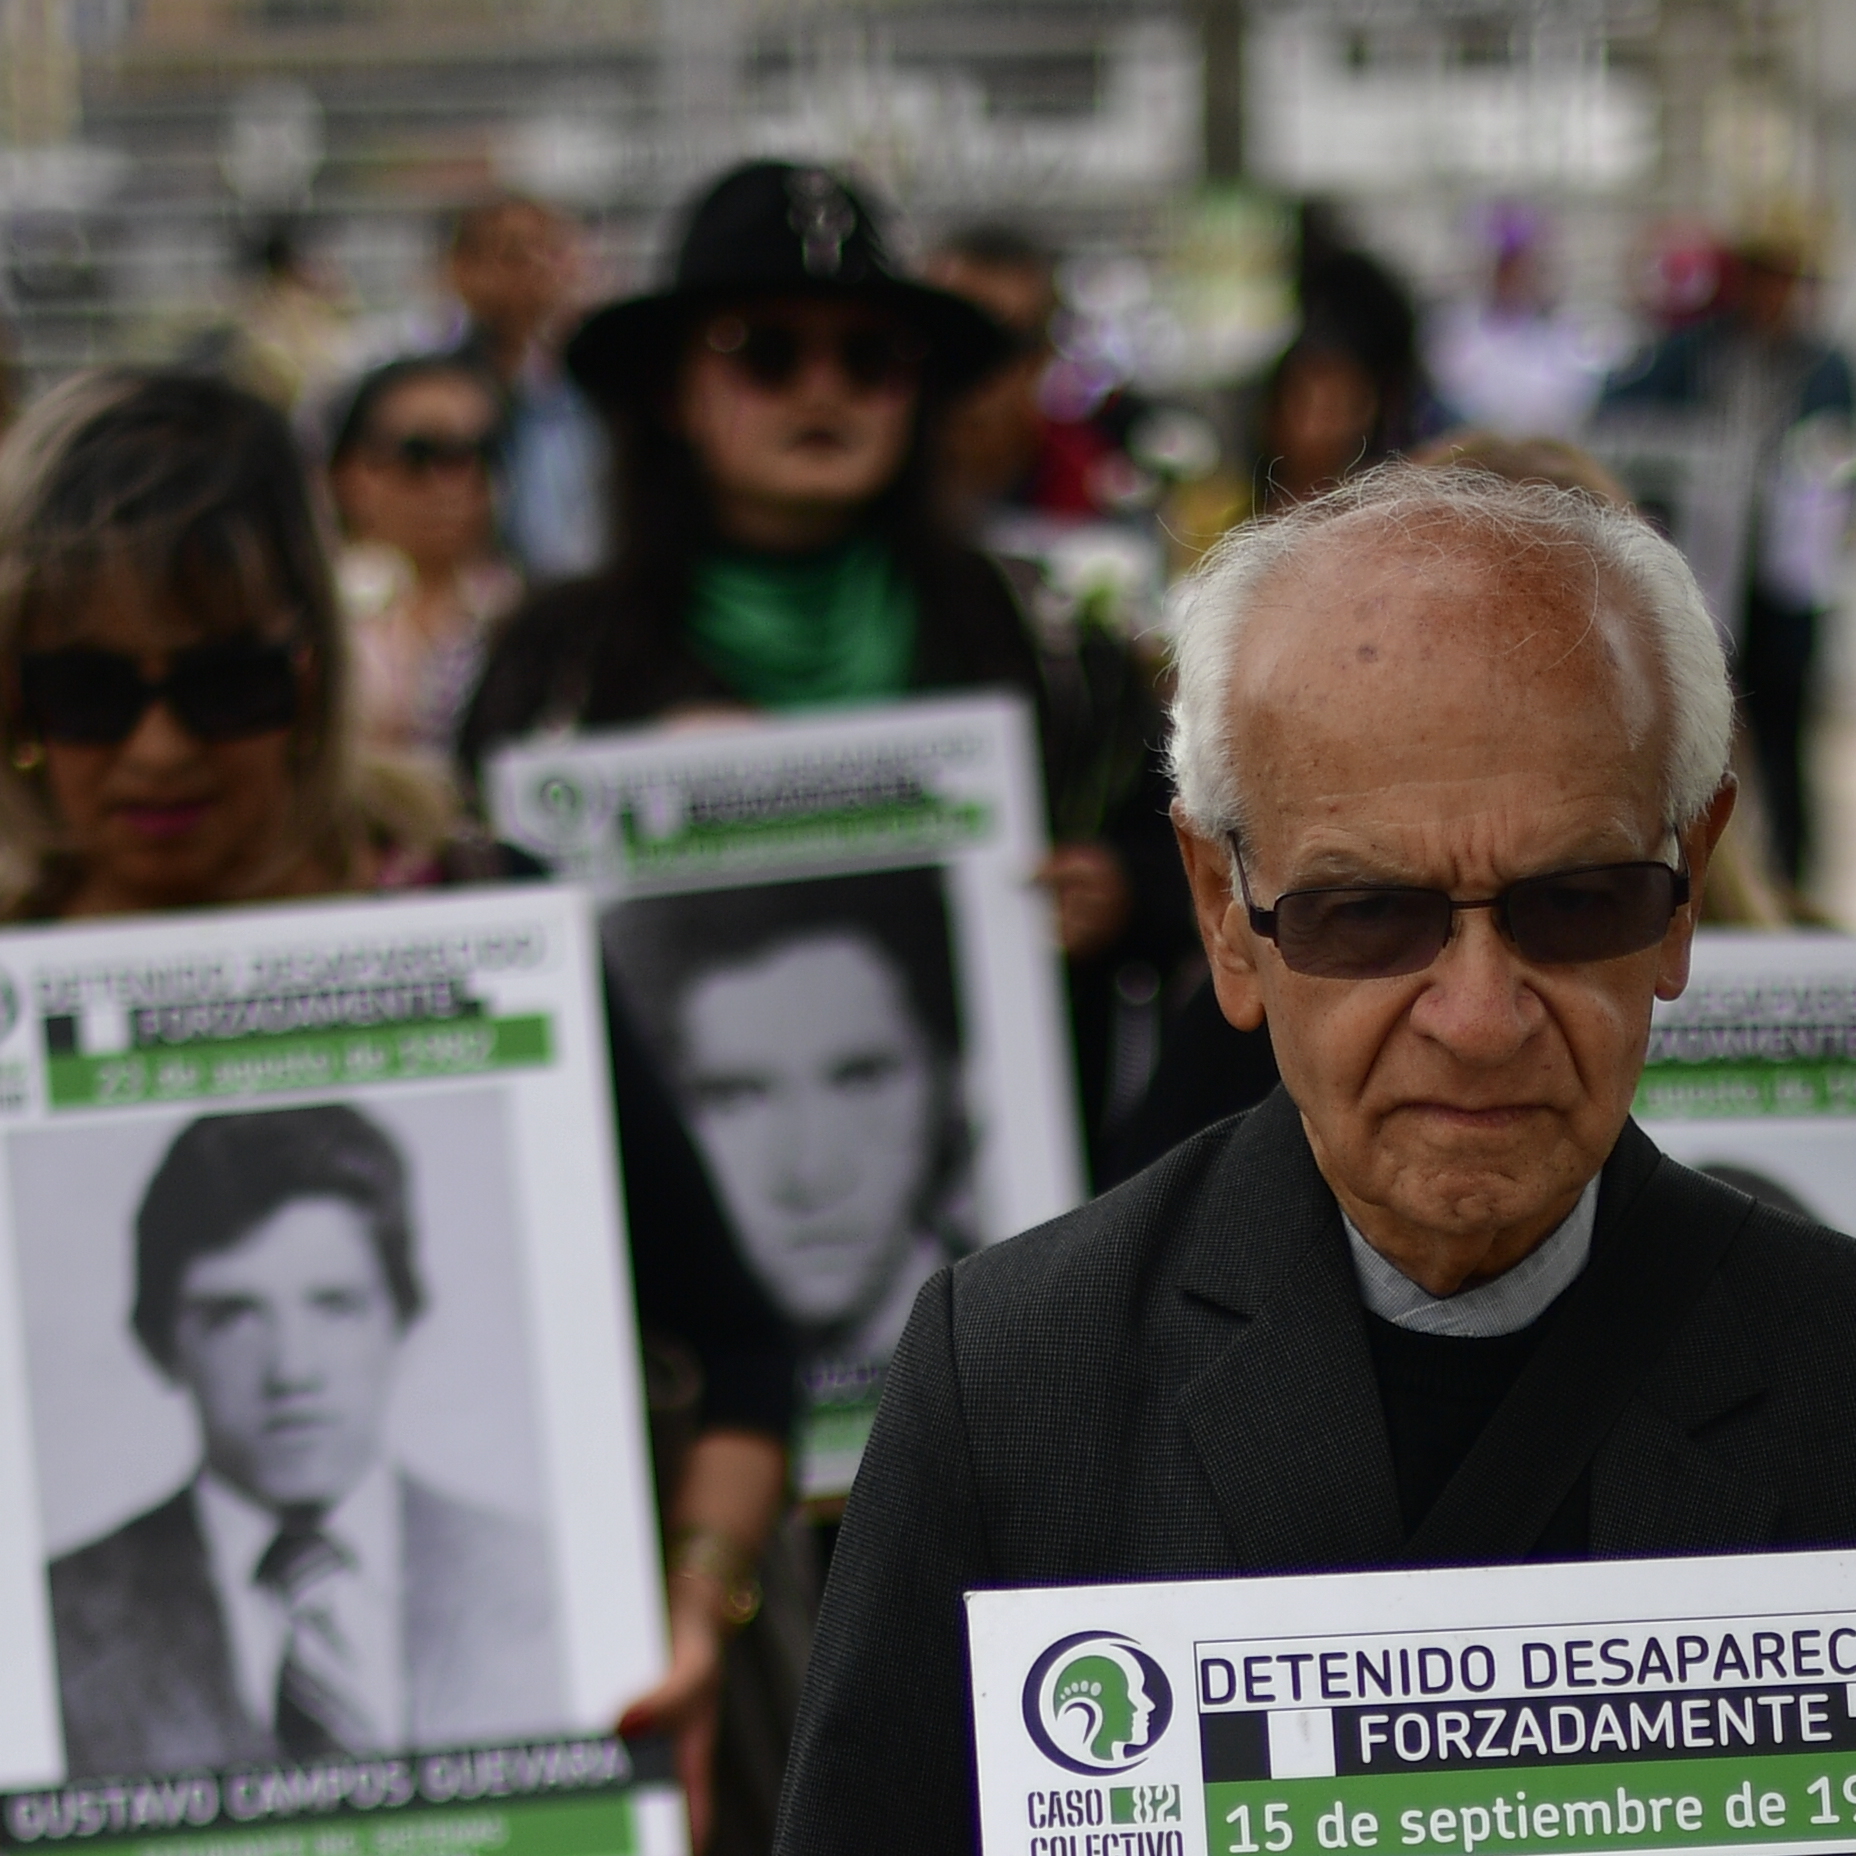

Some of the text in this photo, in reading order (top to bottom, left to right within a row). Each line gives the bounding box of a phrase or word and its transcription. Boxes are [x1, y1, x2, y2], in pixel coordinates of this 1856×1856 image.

[1200, 1646, 1496, 1706] DETENIDO
[1361, 1694, 1833, 1763] FORZADAMENTE
[9, 1740, 632, 1842] GUSTAVO CAMPOS GUEVARA
[1027, 1784, 1181, 1829] CASO 82
[1227, 1803, 1293, 1853] 15
[1316, 1798, 1376, 1850] de
[1400, 1784, 1703, 1852] septiembre
[1724, 1774, 1785, 1825] de
